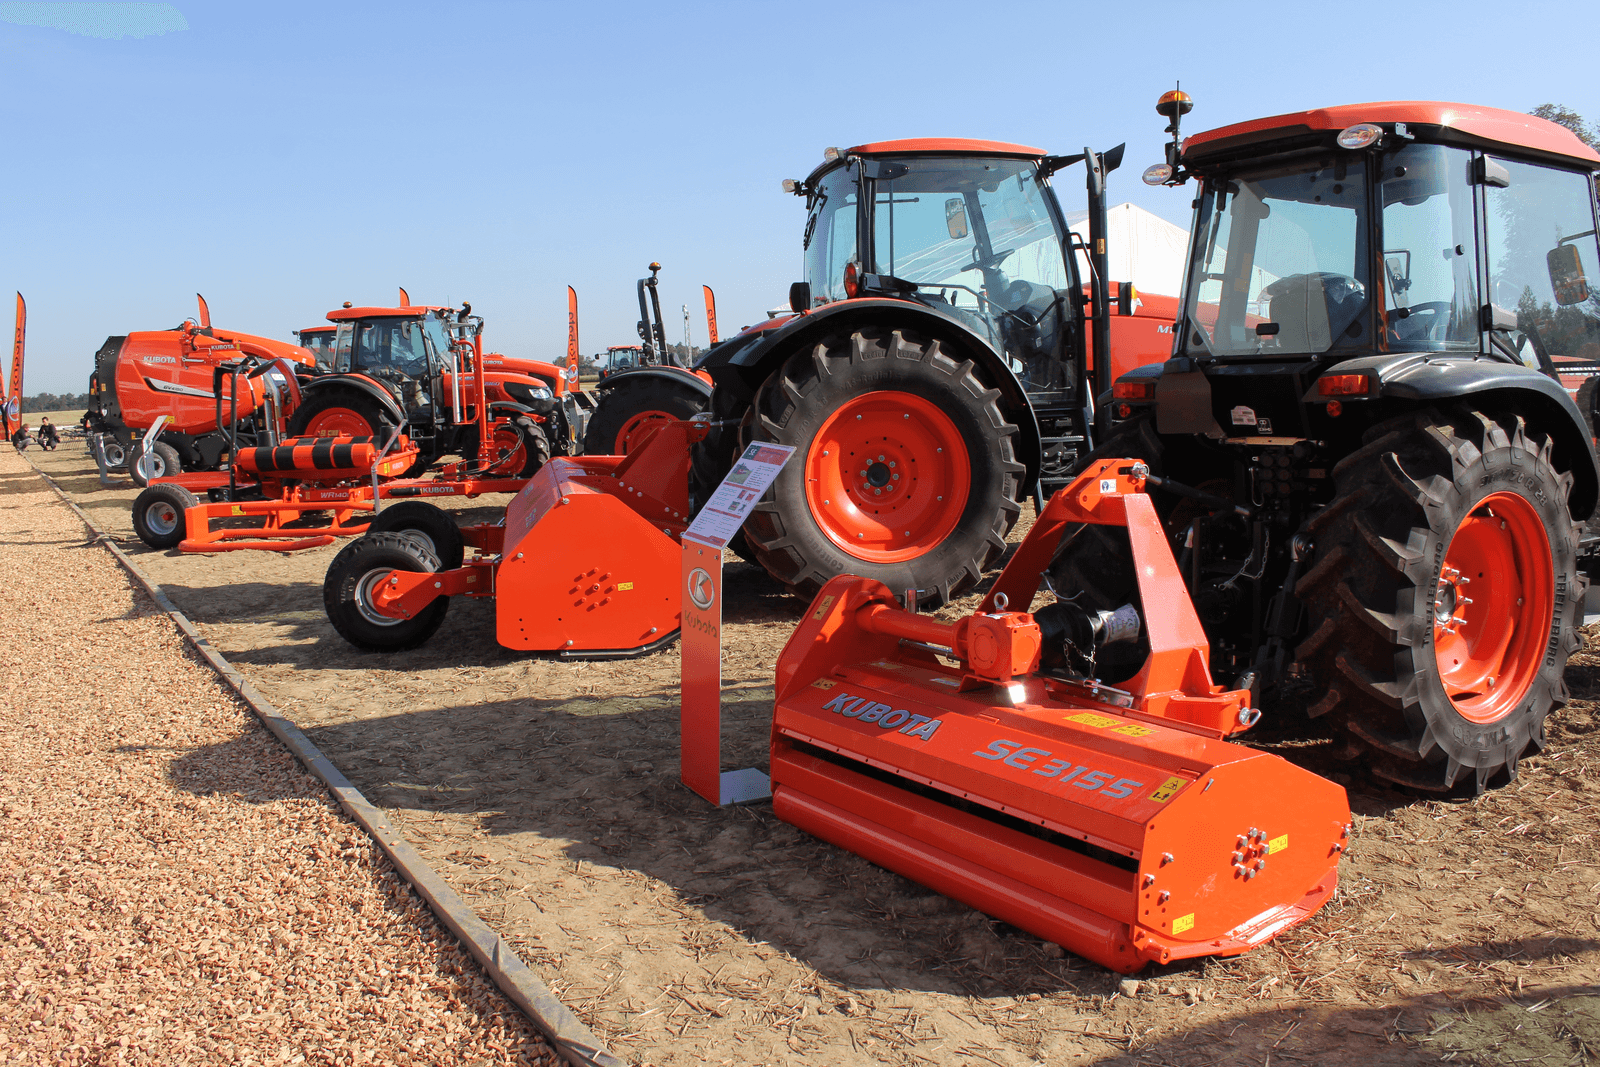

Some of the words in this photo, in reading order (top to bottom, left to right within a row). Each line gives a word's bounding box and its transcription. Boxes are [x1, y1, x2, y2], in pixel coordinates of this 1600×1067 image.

[143, 355, 177, 364] KUBOTA
[685, 610, 717, 638] Kubota
[1546, 572, 1568, 668] TRELLEBORG
[821, 692, 943, 741] KUBOTA
